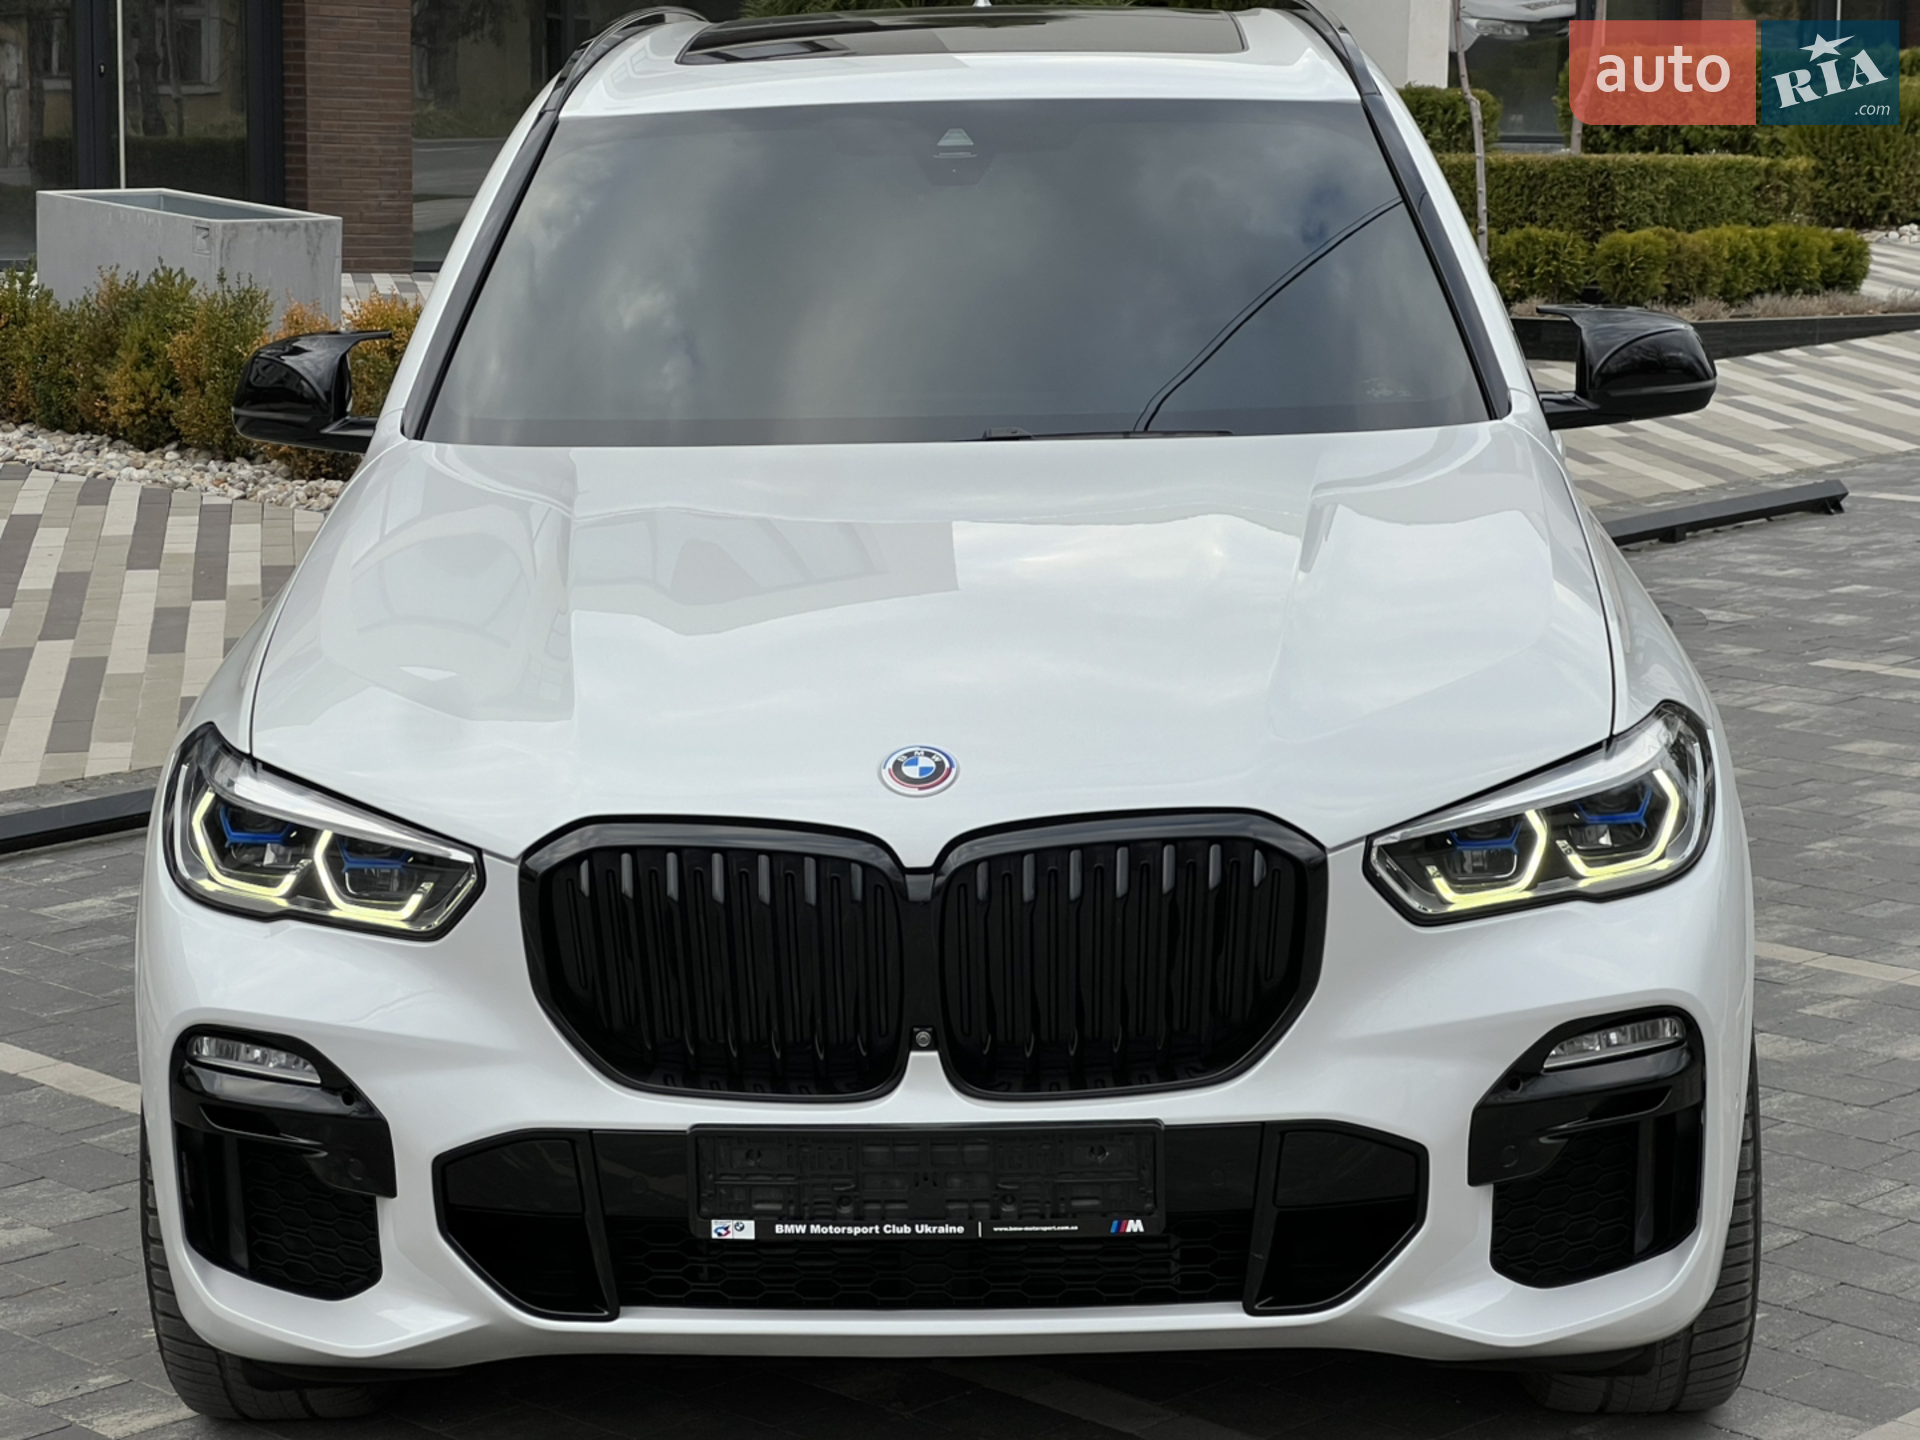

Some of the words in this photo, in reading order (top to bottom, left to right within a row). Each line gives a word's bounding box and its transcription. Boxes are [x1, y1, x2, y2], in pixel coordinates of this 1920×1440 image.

[775, 1224, 807, 1234] BMW
[810, 1224, 880, 1236] Motorsport
[883, 1224, 912, 1234] Club
[914, 1224, 965, 1234] Ukraine
